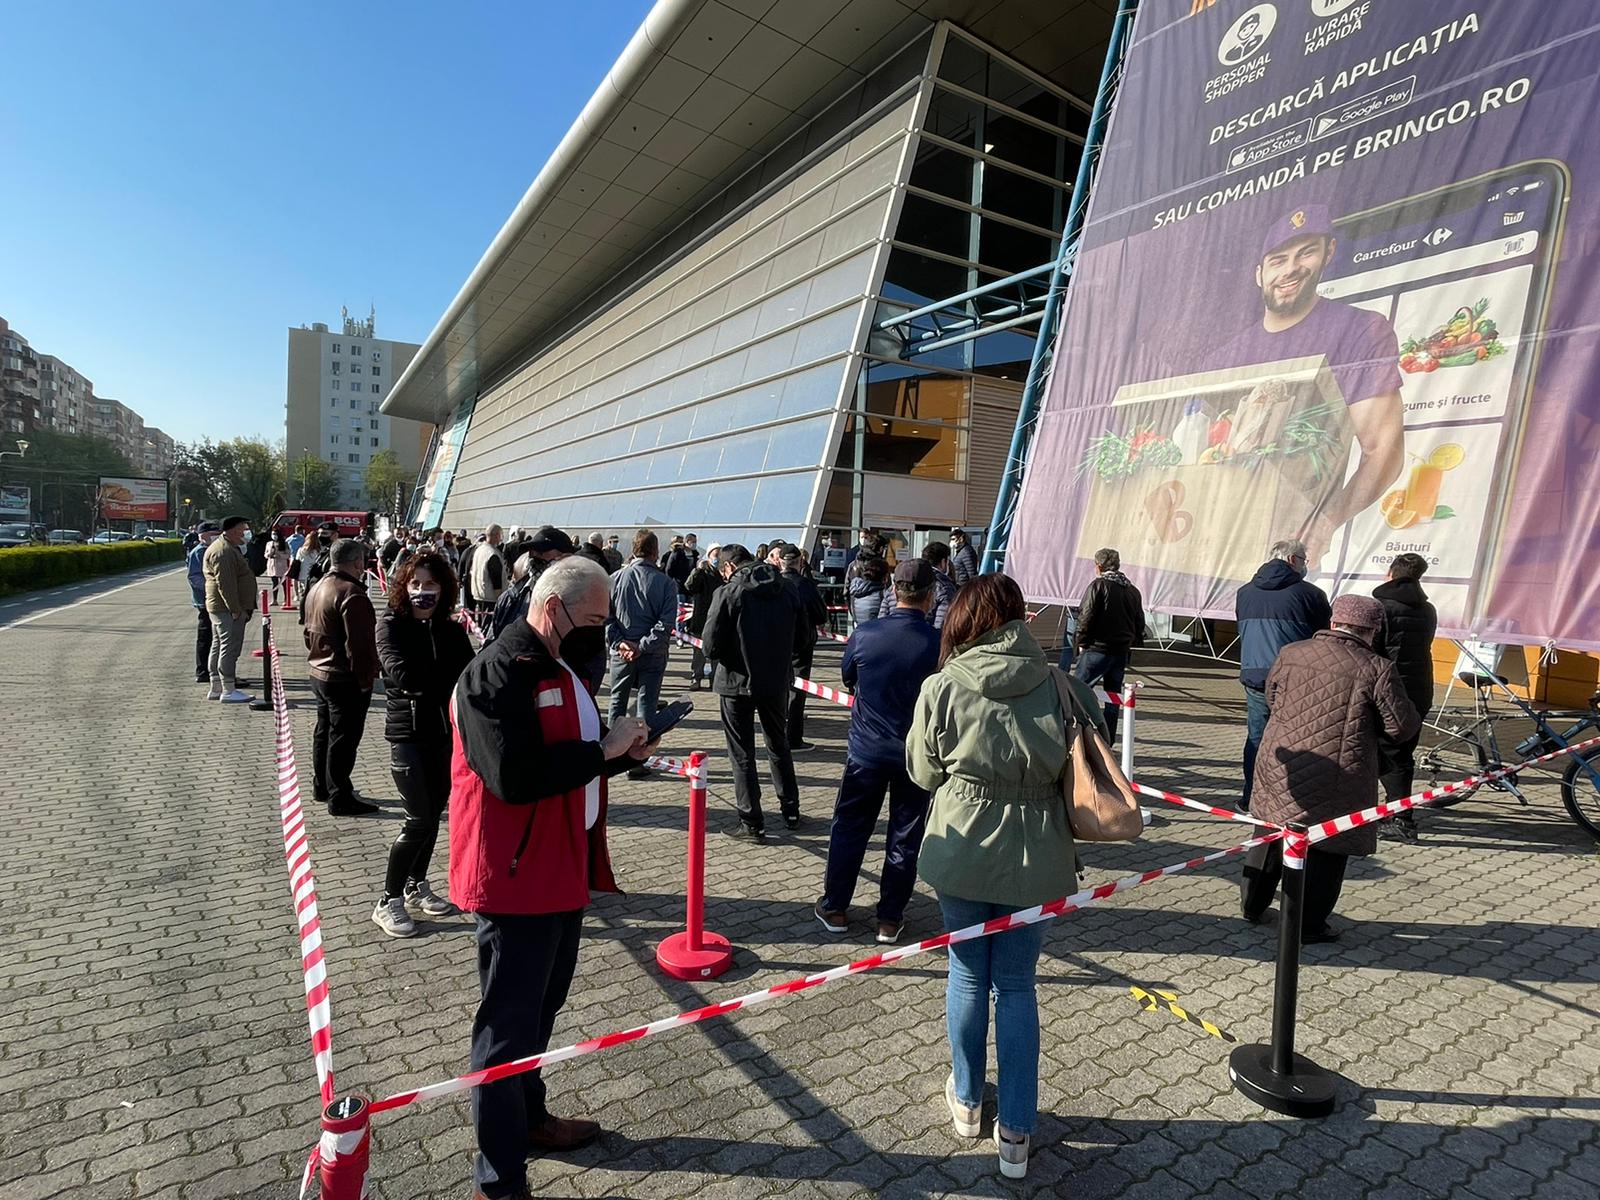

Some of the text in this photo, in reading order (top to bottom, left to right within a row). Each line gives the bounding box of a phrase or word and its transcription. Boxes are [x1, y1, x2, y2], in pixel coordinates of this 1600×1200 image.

[1304, 1, 1371, 44] LIVRARE
[1304, 16, 1363, 56] RAPIDĂ
[1204, 52, 1272, 93] PERSONAL
[1204, 67, 1266, 104] SHOPPER
[1208, 12, 1481, 145] DESCARCĂ APLICAȚIA
[1340, 100, 1383, 123] Google
[1383, 89, 1411, 106] Play
[1152, 76, 1532, 230] SAU COMANDĂ PE BRINGO.RO
[1246, 134, 1302, 162] App Store
[1352, 239, 1418, 264] Carrefour
[1451, 393, 1492, 406] fructe
[1385, 541, 1432, 552] Băuturi
